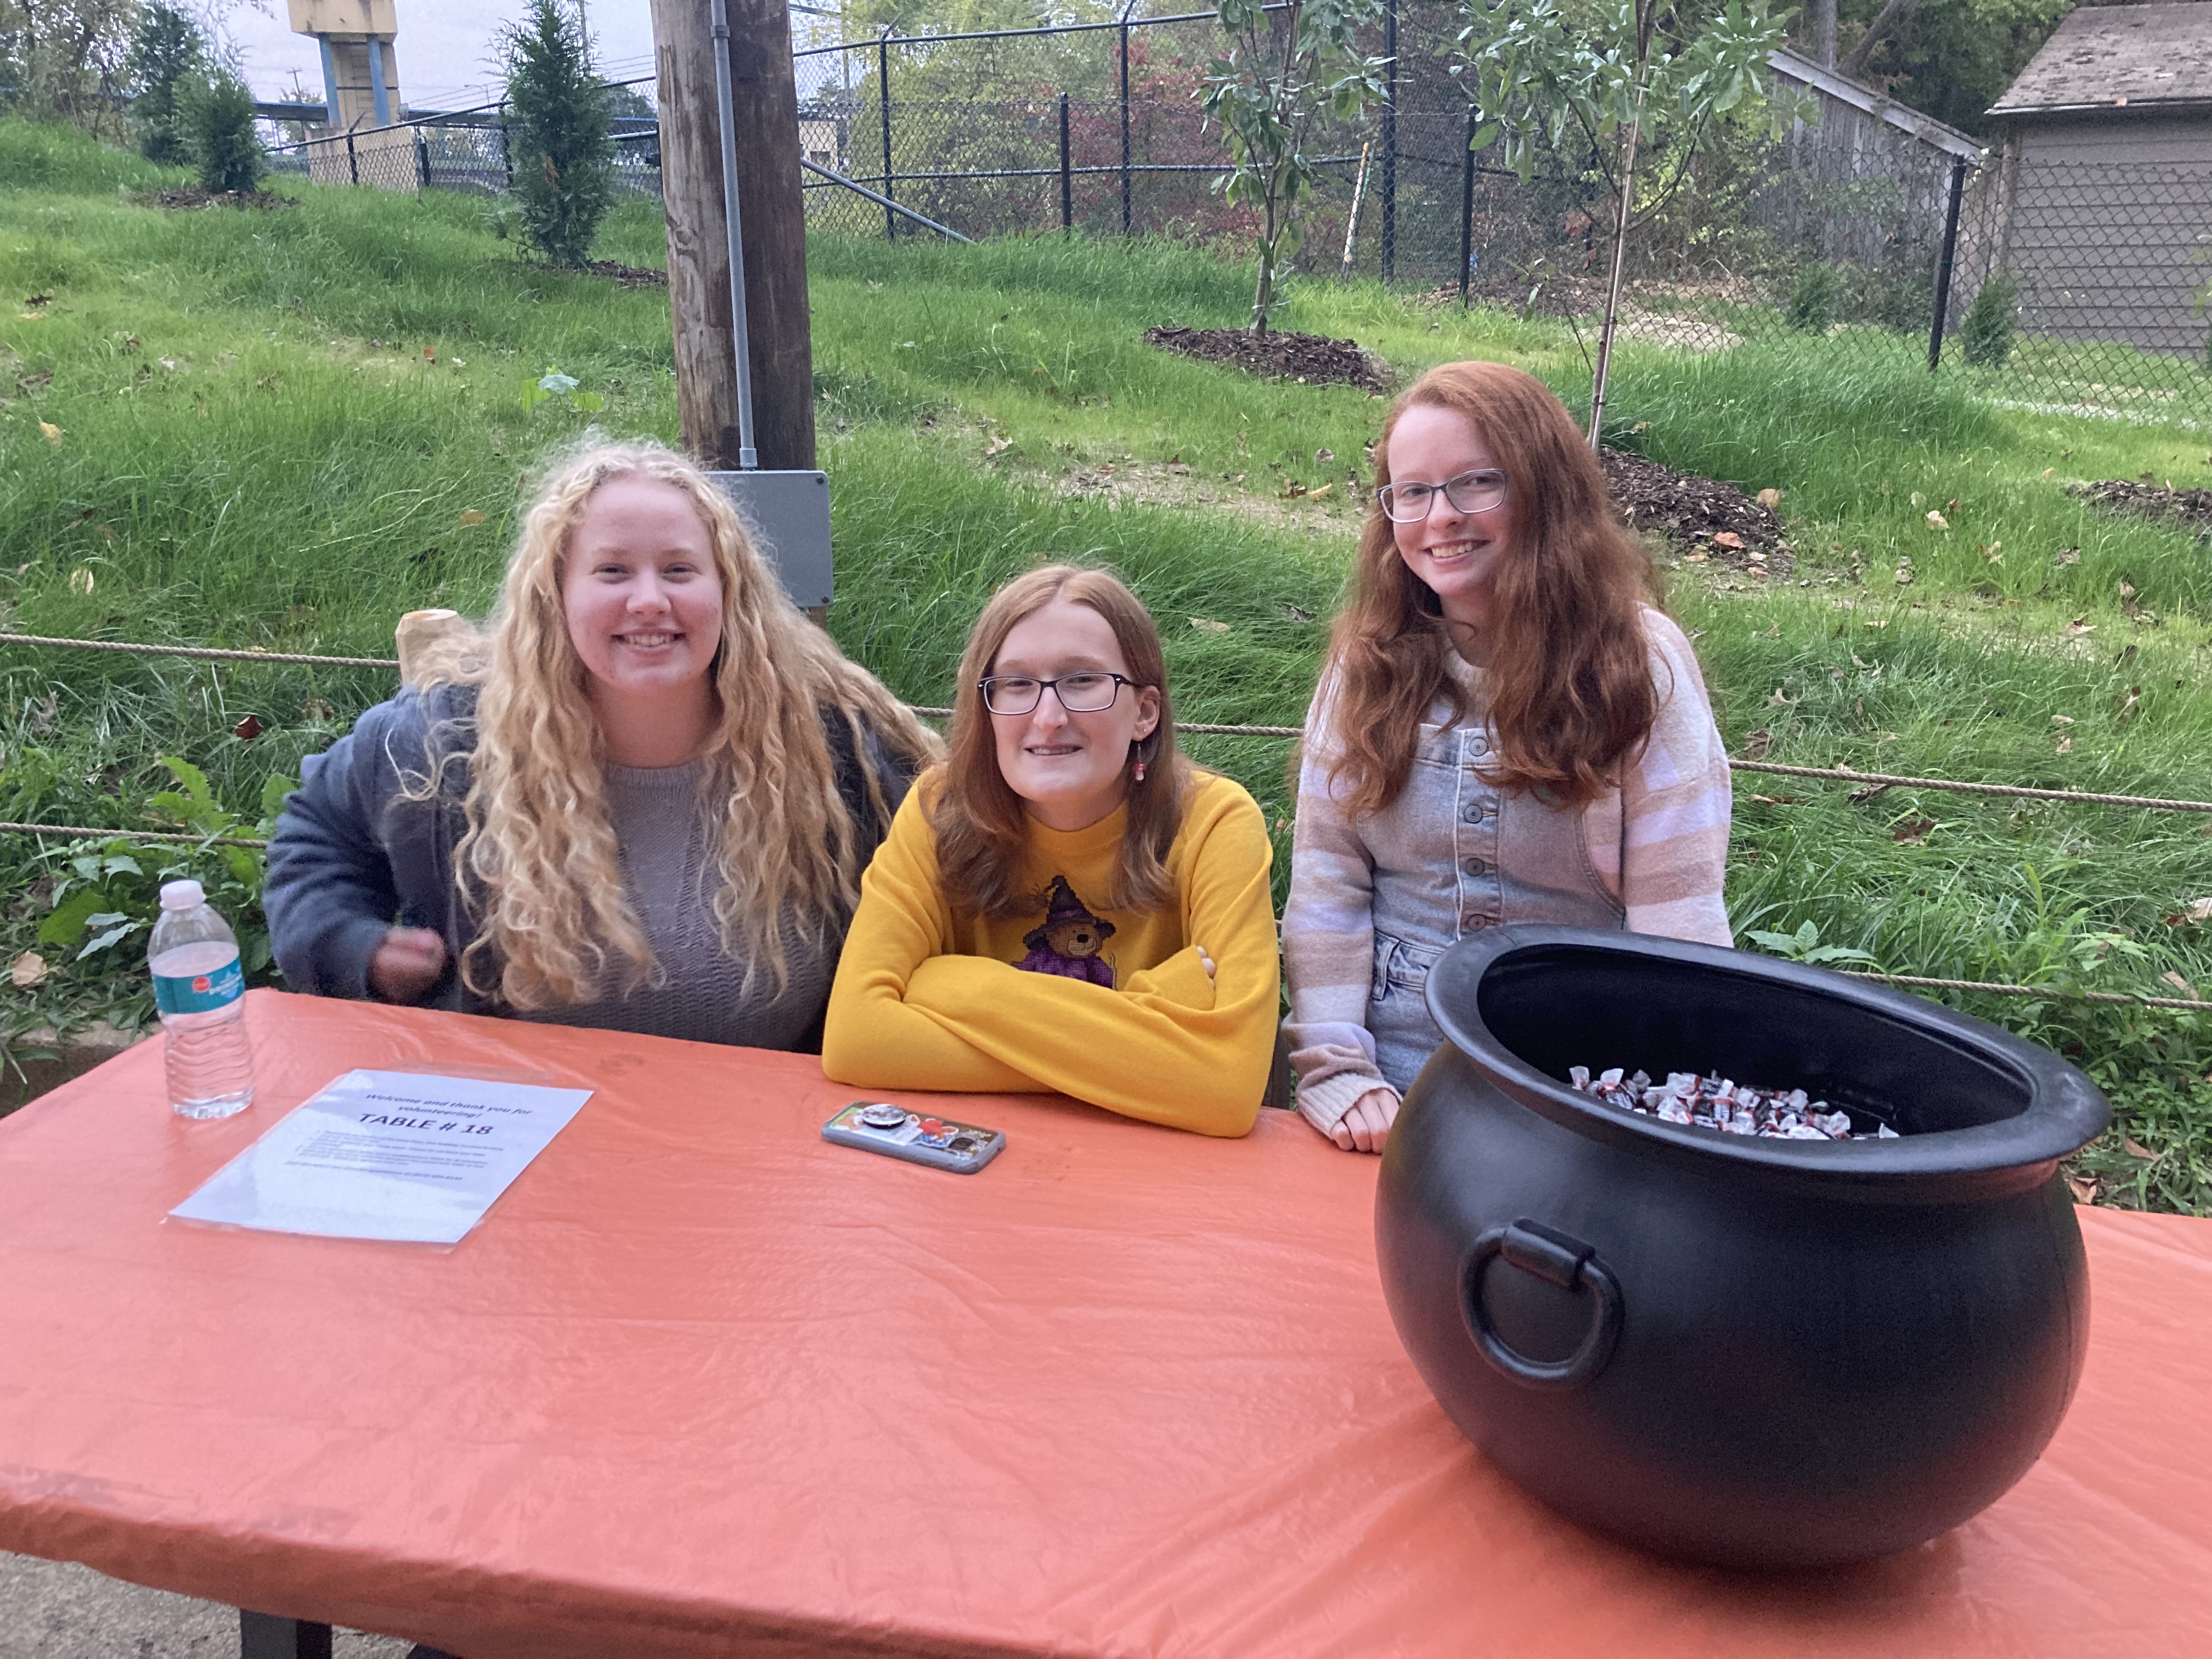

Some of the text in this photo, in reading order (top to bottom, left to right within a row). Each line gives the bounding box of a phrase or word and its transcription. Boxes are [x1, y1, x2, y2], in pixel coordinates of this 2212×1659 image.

[366, 1094, 422, 1104] Welcome
[450, 1102, 484, 1110] thank
[398, 1105, 483, 1119] volunteering!
[359, 1113, 494, 1135] TABLE # 18
